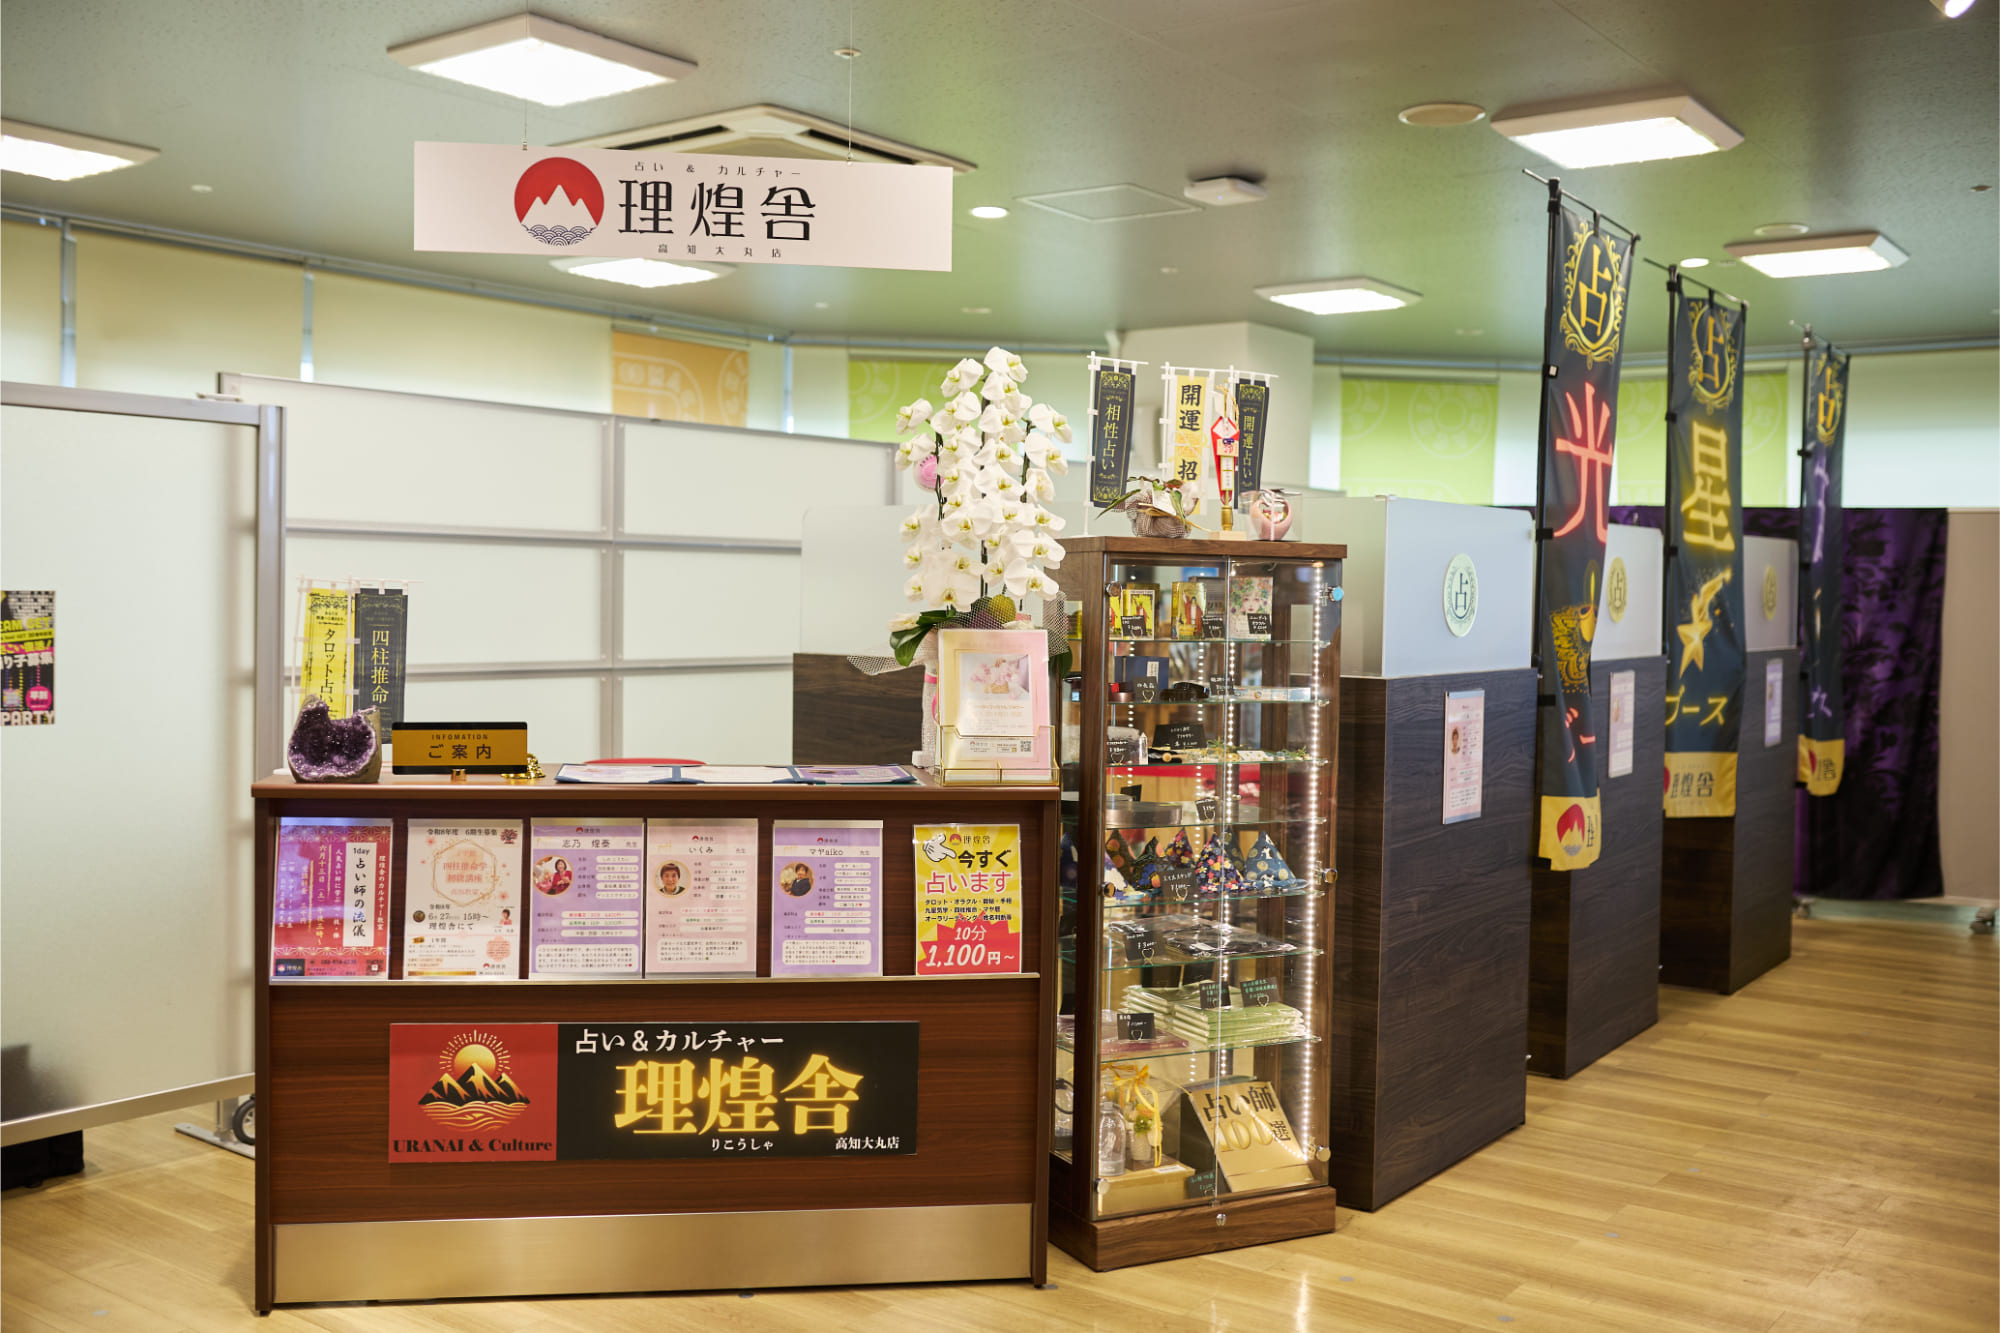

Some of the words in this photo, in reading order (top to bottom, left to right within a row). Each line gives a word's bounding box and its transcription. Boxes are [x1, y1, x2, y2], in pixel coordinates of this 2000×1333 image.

[634, 160, 664, 173] 占い
[685, 164, 696, 174] &
[717, 164, 802, 178] カルチャー
[618, 178, 816, 241] 理煌舎
[657, 244, 782, 259] 高知大丸店
[1579, 243, 1612, 337] 占
[1179, 384, 1203, 432] 開運
[1101, 404, 1121, 471] 相性占い
[1242, 415, 1255, 479] 開運占い
[1178, 459, 1199, 481] 招
[1553, 381, 1613, 544] 光
[1680, 420, 1736, 552] 星
[26, 616, 51, 629] GET
[320, 628, 337, 705] タロット占い
[371, 630, 390, 704] 四柱推命
[2, 710, 55, 726] PARTY
[428, 743, 492, 760] ご案内
[353, 848, 370, 857] 1day
[688, 846, 714, 854] いくみ
[958, 849, 1012, 869] 今すぐ
[926, 871, 1012, 894] 占います
[352, 858, 367, 937] 占い師の流儀
[954, 925, 987, 941] 10分
[615, 1053, 865, 1137] 理煌舎
[1203, 1085, 1277, 1122] 占い師
[393, 1139, 464, 1153] URANAI
[468, 1138, 484, 1153] &
[487, 1137, 553, 1152] Culture
[711, 1137, 774, 1152] りこうしゃ
[834, 1135, 901, 1151] 高知大丸店
